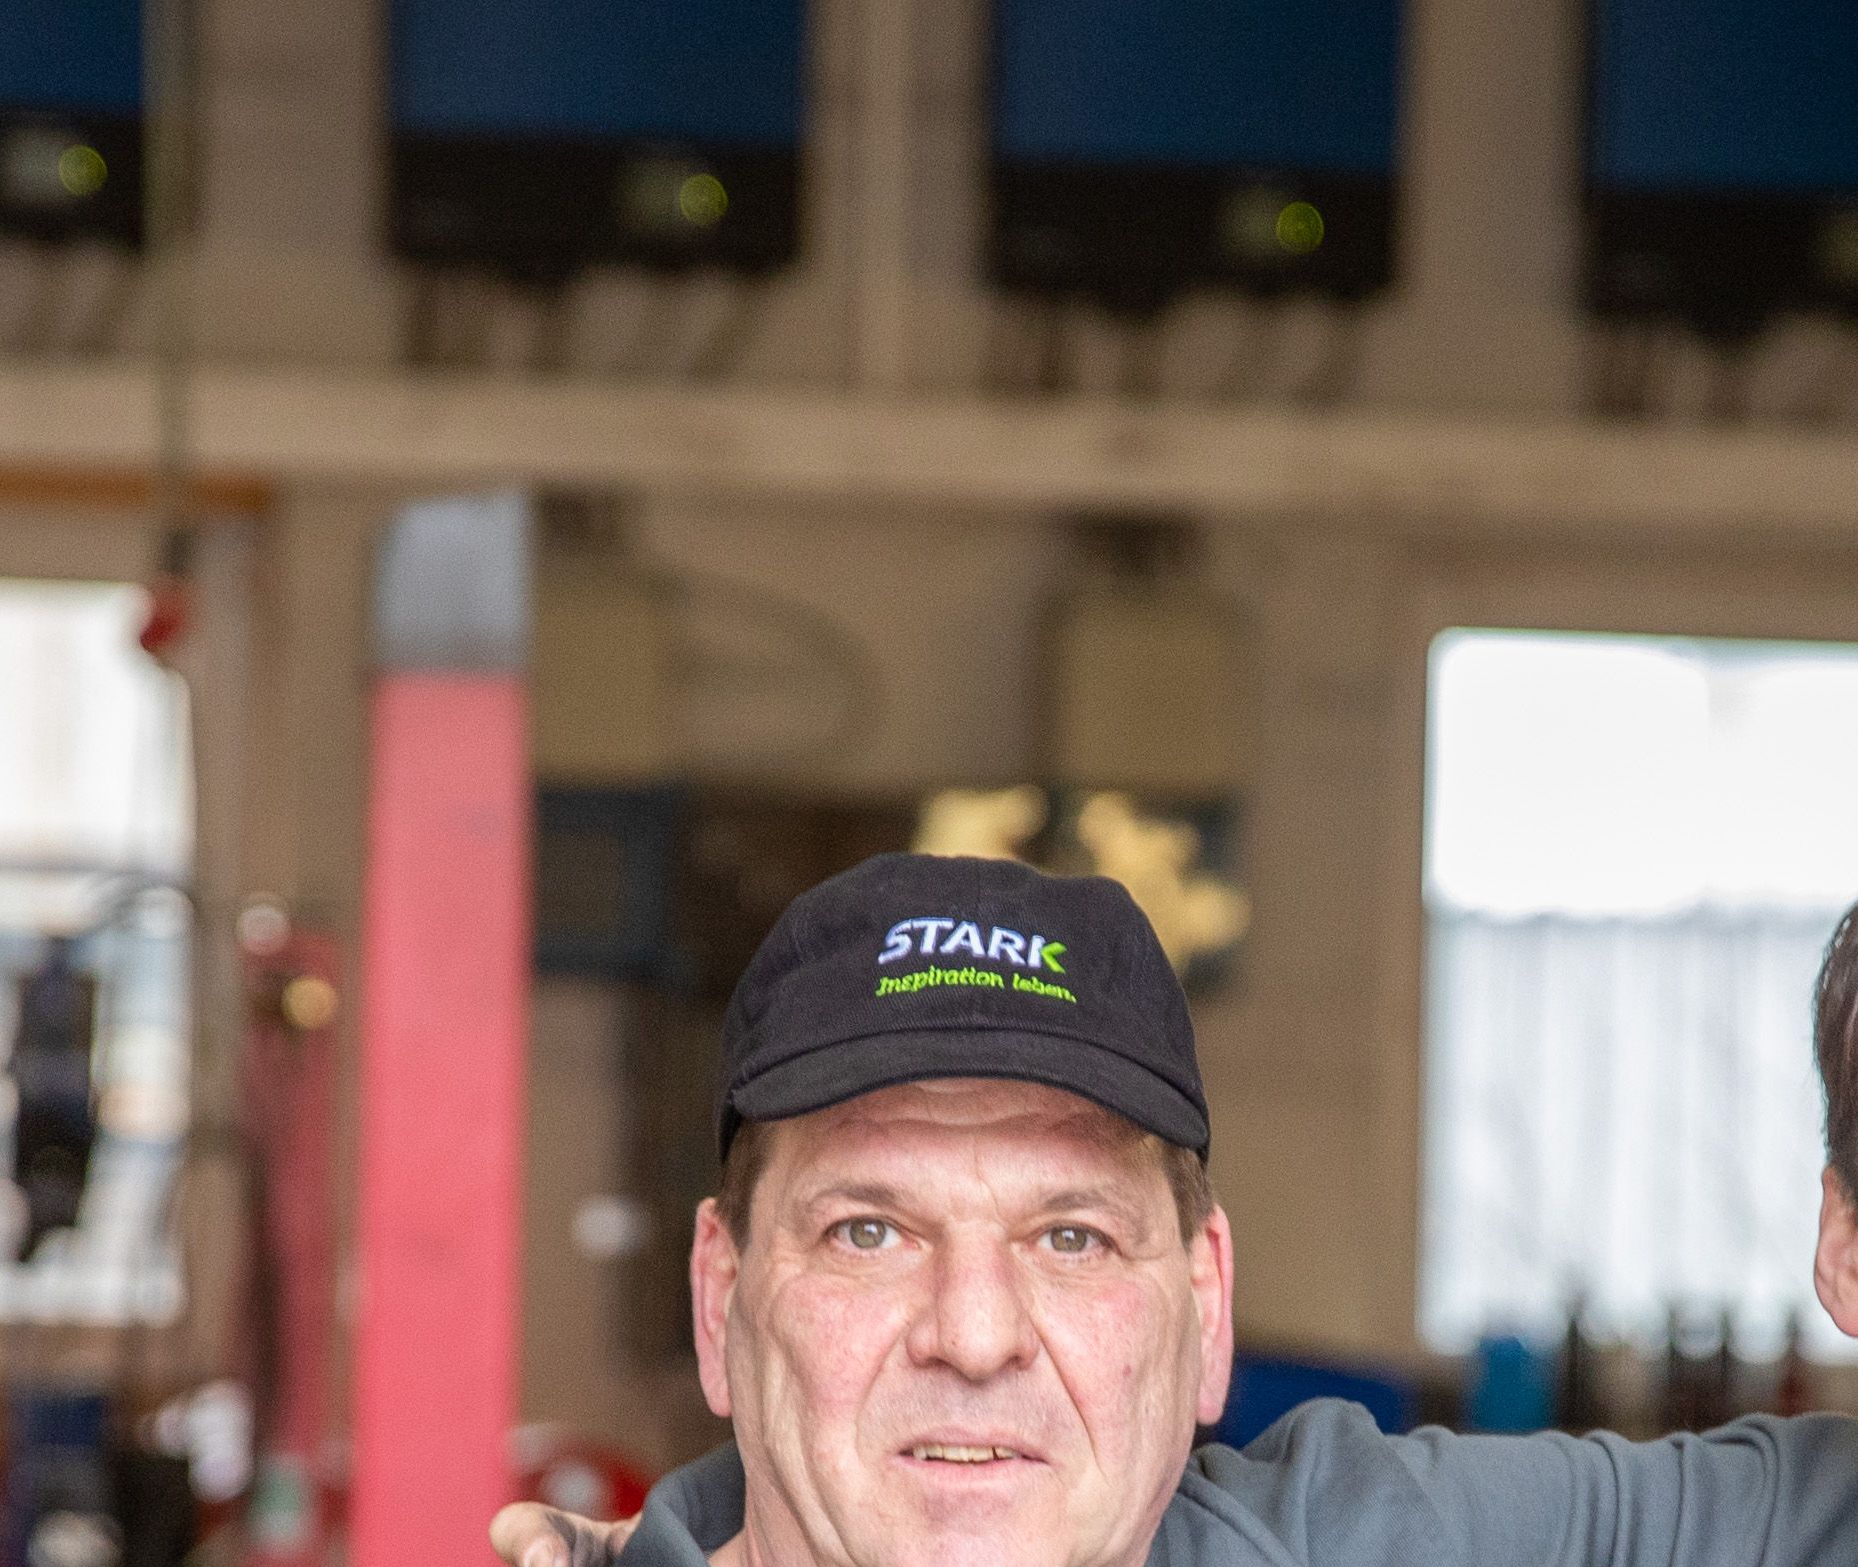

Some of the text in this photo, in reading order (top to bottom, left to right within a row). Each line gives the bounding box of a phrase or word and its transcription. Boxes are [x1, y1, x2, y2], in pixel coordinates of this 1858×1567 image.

[877, 916, 1067, 974] STARK
[875, 965, 1077, 1004] Inspiration leben.
